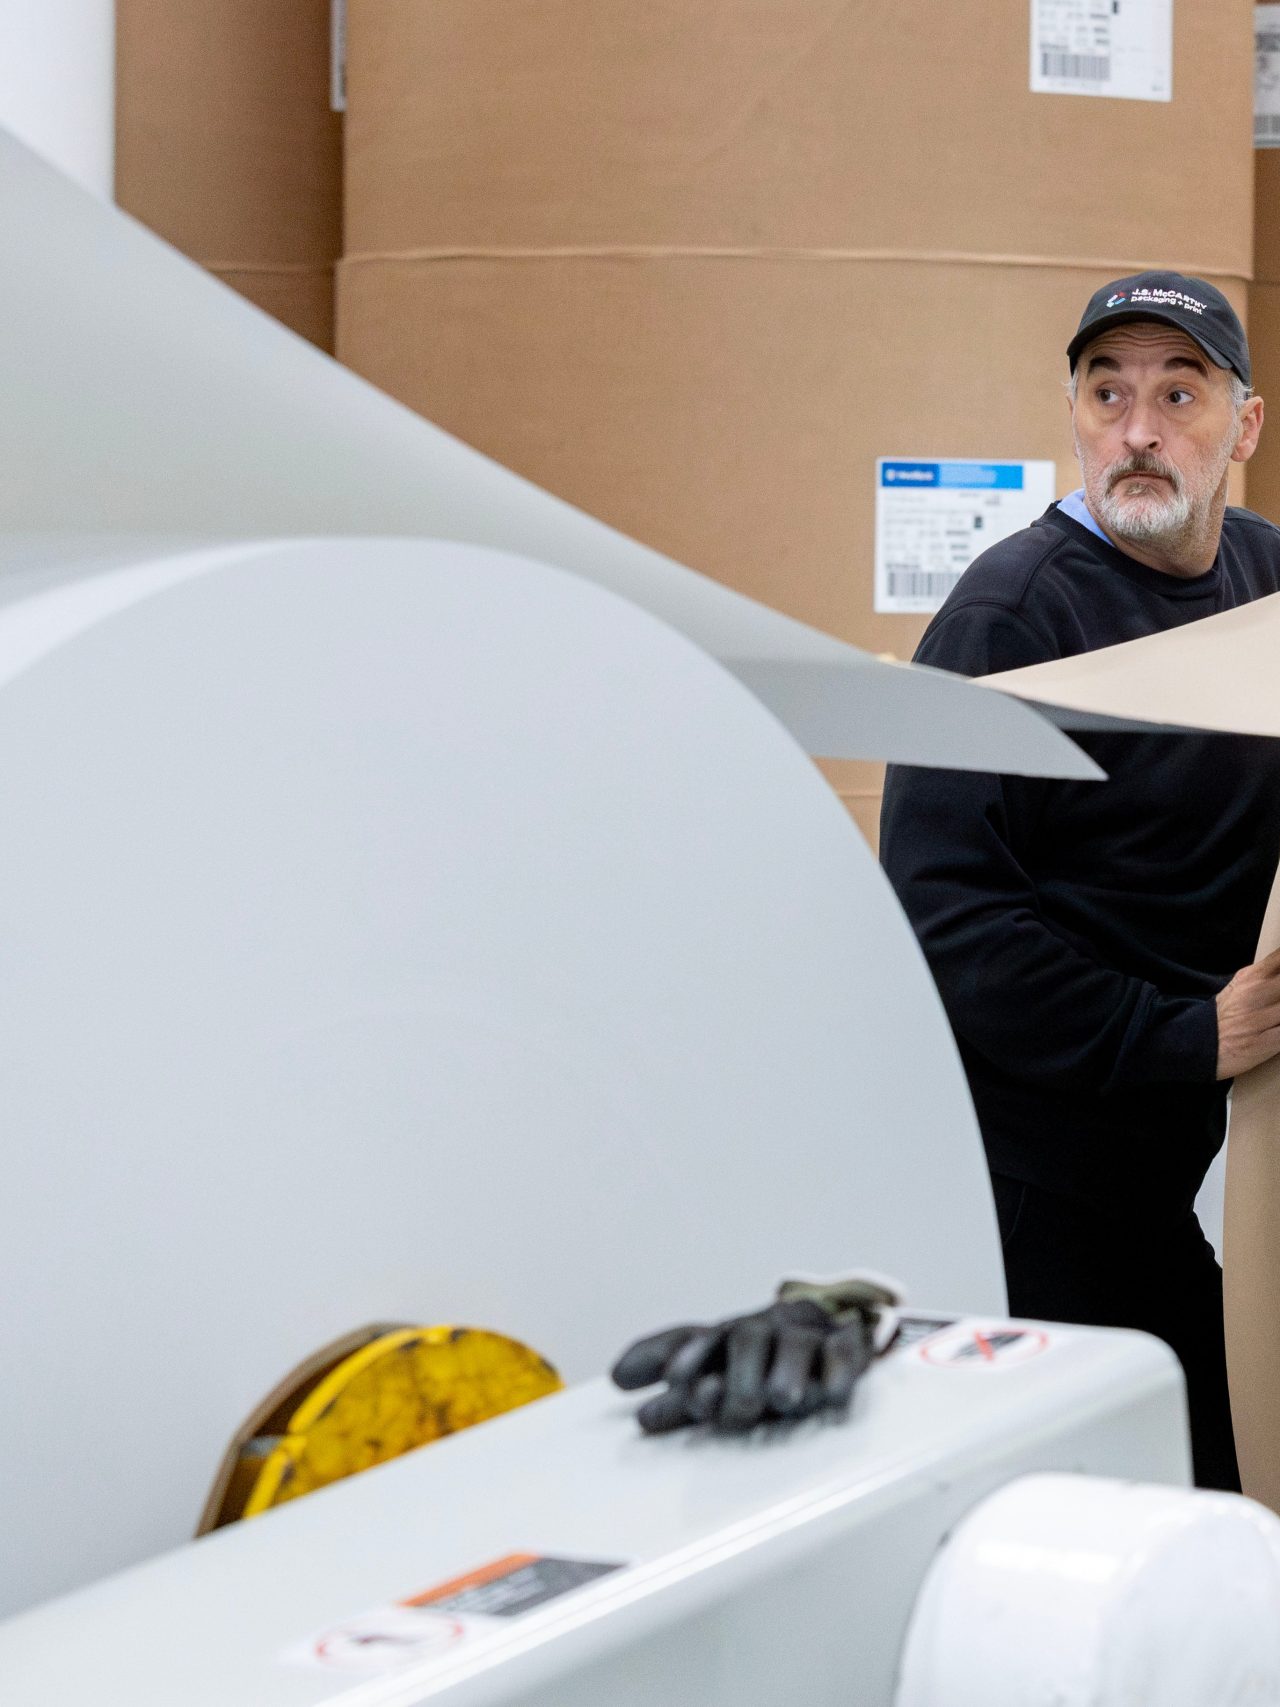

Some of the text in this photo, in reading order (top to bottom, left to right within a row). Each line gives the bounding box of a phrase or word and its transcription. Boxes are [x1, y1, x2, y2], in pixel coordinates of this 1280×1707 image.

[1131, 295, 1176, 305] packaging
[1184, 303, 1203, 315] print
[1153, 289, 1207, 310] McCARTHY
